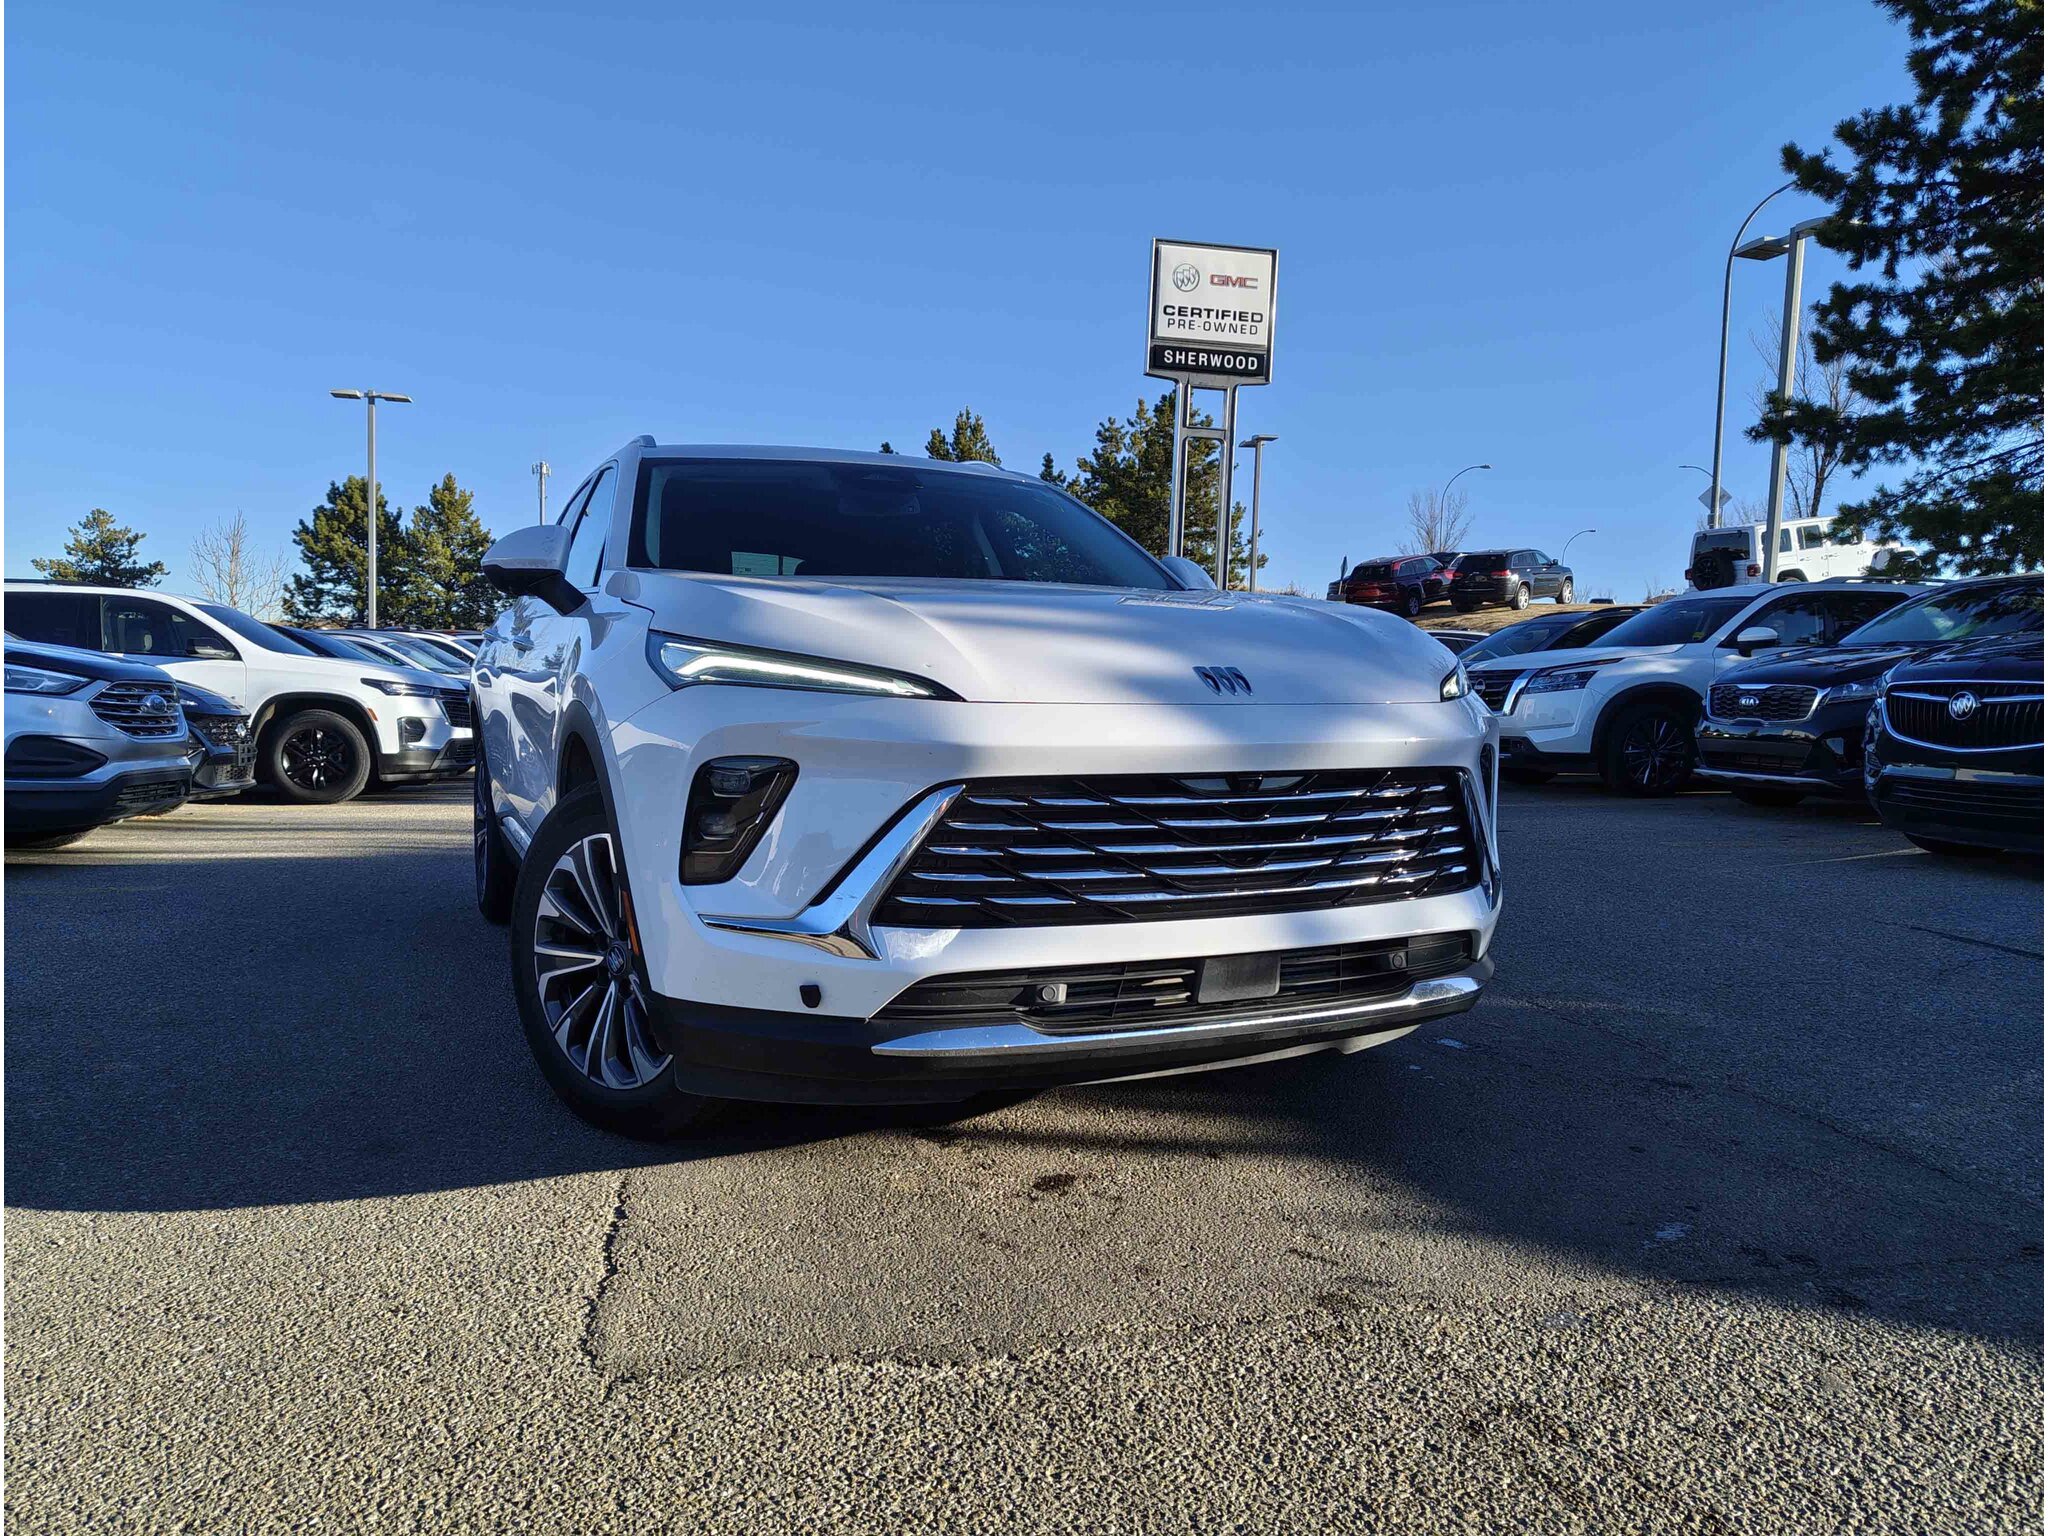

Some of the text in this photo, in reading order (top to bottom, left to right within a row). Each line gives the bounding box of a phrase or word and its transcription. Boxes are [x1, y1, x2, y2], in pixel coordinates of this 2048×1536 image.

[1210, 274, 1259, 290] GMC
[1163, 305, 1263, 323] CERTIFIED
[1167, 318, 1258, 335] PRE-OWNED
[1163, 350, 1258, 370] SHERWOOD
